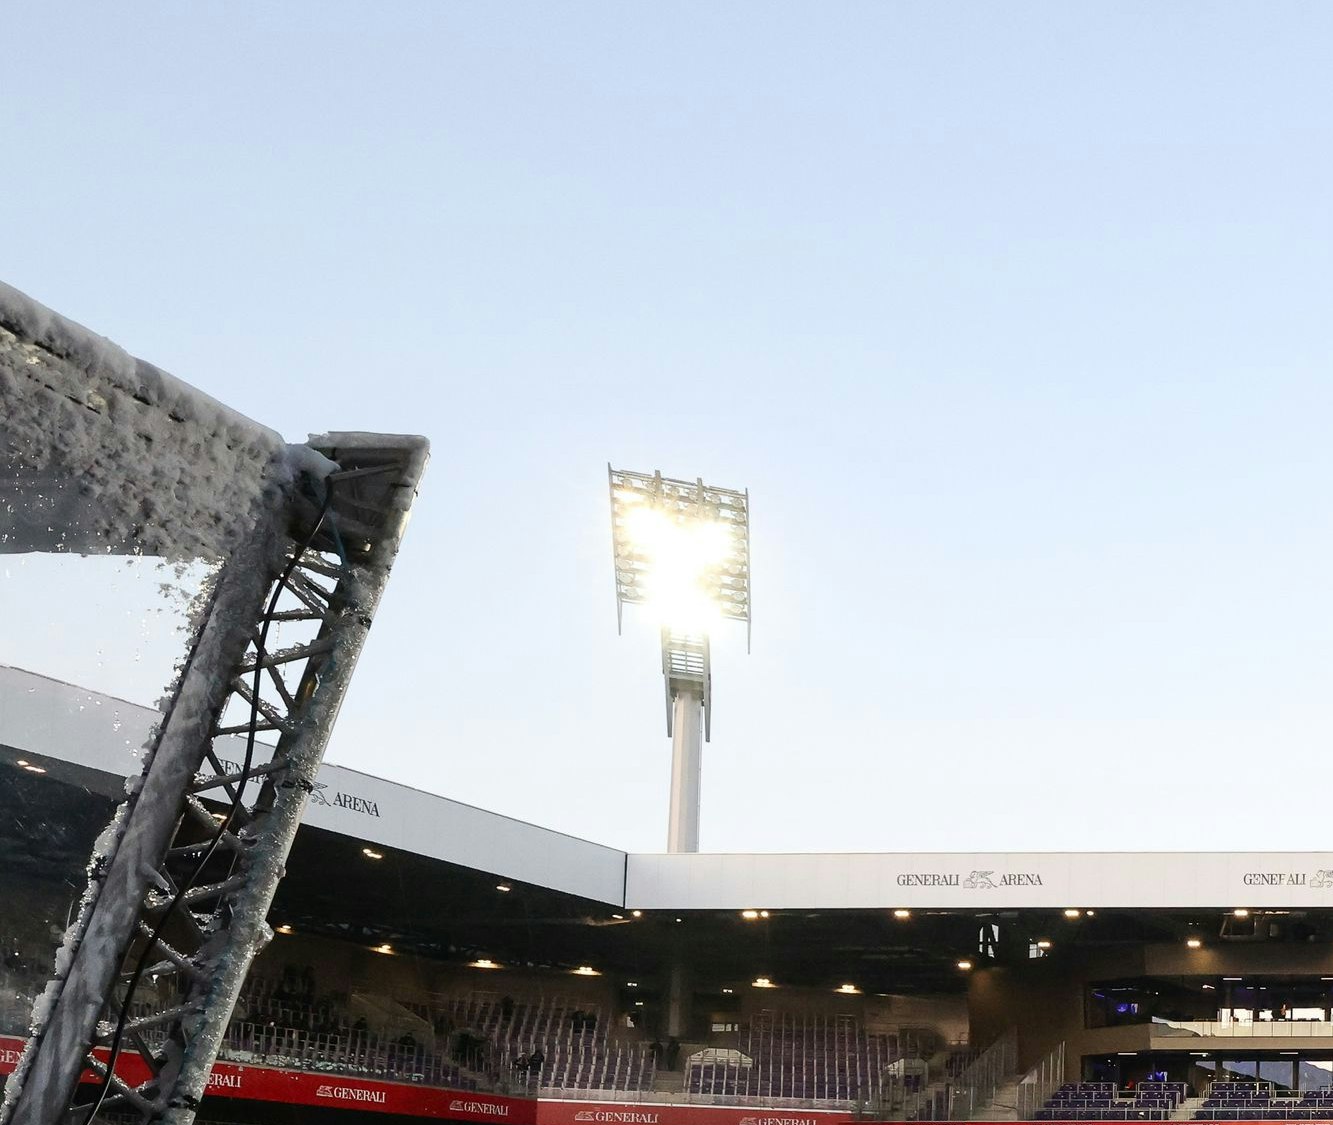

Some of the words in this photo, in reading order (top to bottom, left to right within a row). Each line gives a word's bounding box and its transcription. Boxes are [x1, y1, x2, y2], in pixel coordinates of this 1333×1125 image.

[332, 791, 380, 817] ARENA
[896, 873, 960, 887] GENERALI
[999, 873, 1043, 886] ARENA
[333, 1086, 385, 1103] GENERALI
[464, 1101, 508, 1116] GENERALI
[595, 1111, 658, 1124] GENERALI
